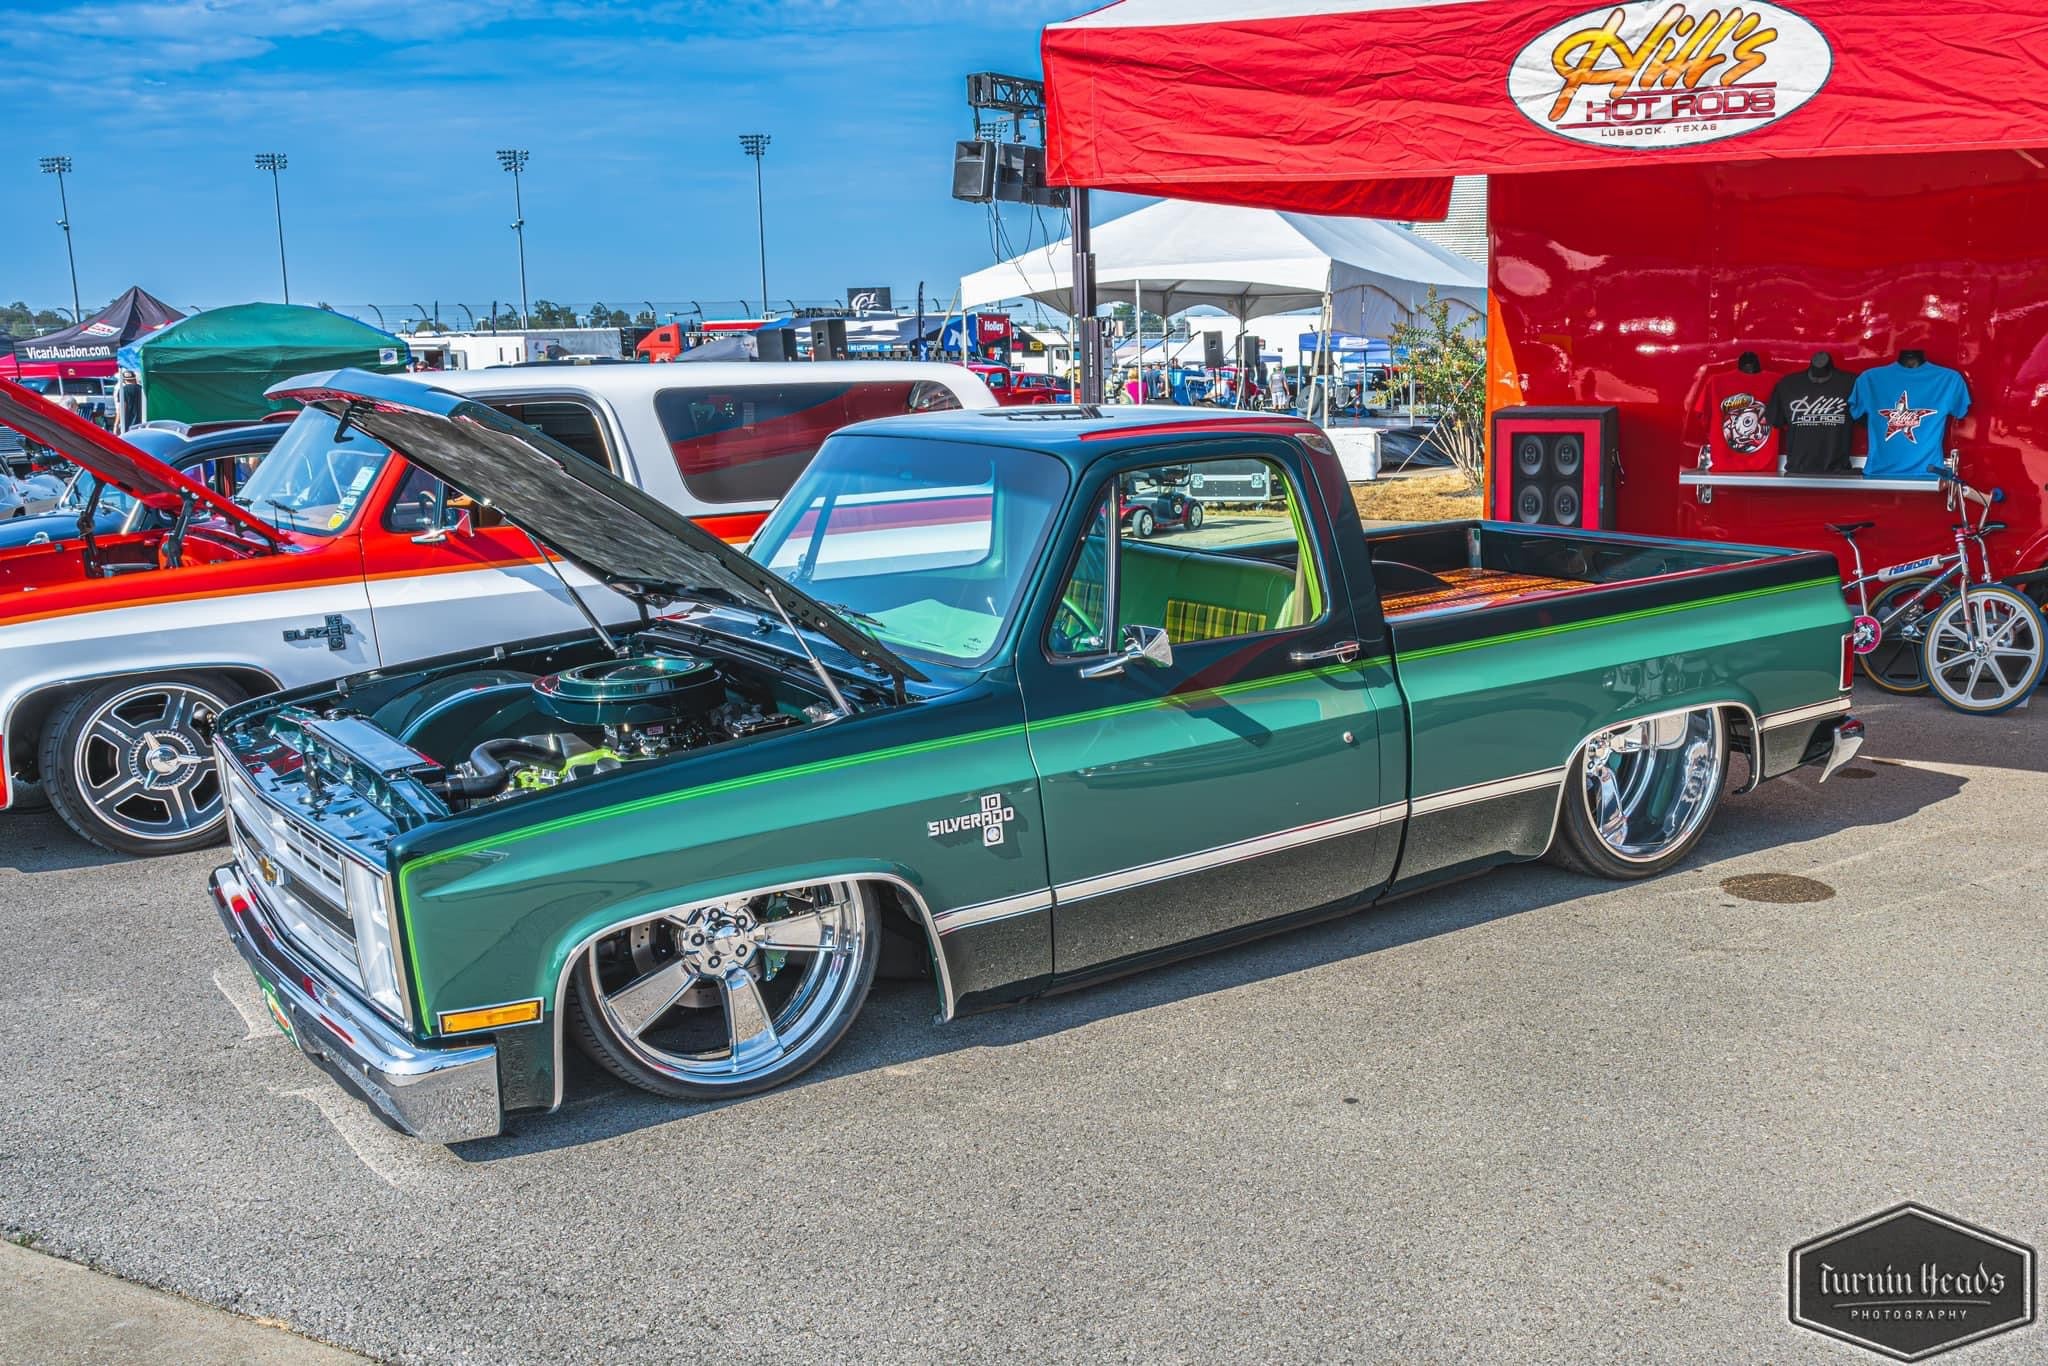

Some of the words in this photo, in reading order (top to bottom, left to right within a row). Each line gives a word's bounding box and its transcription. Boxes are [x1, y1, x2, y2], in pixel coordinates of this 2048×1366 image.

[1548, 3, 1778, 122] Hill's
[1586, 100, 1661, 121] HOT
[1672, 89, 1776, 117] RODS
[1675, 123, 1718, 133] TEXAS
[984, 321, 1004, 334] Holley
[26, 345, 110, 359] VicariAuction.com
[1790, 395, 1847, 422] Hill's
[283, 624, 353, 642] BLAZER
[984, 796, 998, 810] 10
[928, 807, 1014, 837] SILVERADO
